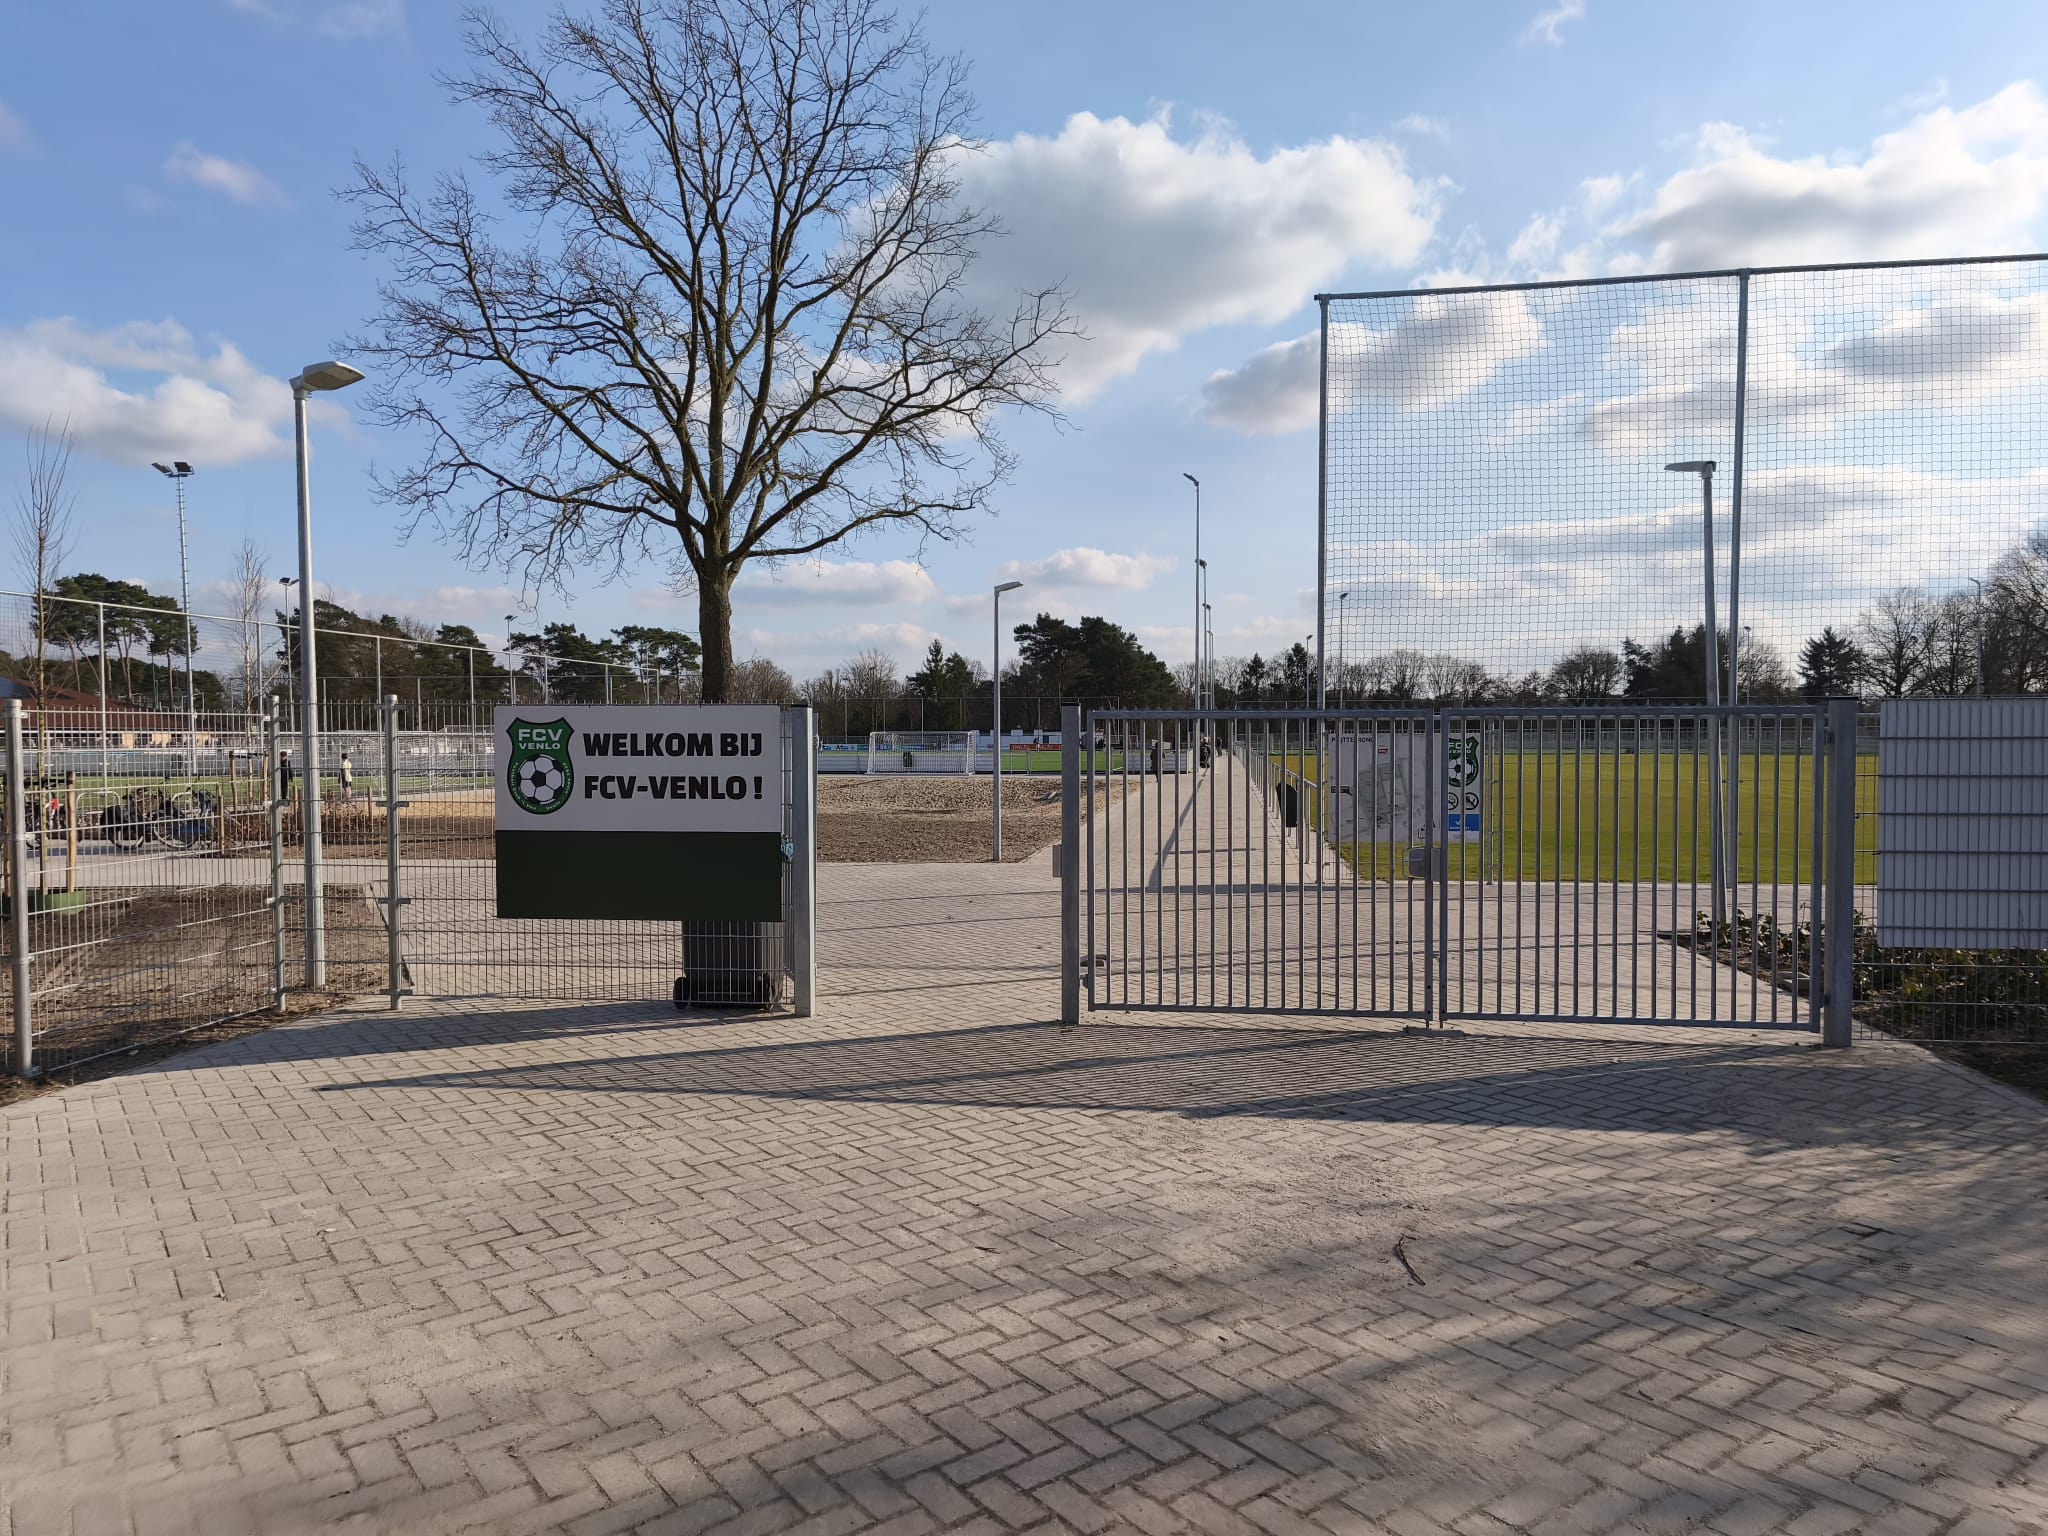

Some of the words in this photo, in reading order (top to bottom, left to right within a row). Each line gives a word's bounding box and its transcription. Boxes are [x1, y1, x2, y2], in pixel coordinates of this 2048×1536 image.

[518, 728, 563, 741] FCV
[518, 742, 561, 750] VENLO
[583, 733, 713, 757] WELKOM
[720, 733, 762, 757] BIJ
[584, 775, 747, 800] FCV-VENLO
[754, 776, 763, 800] !
